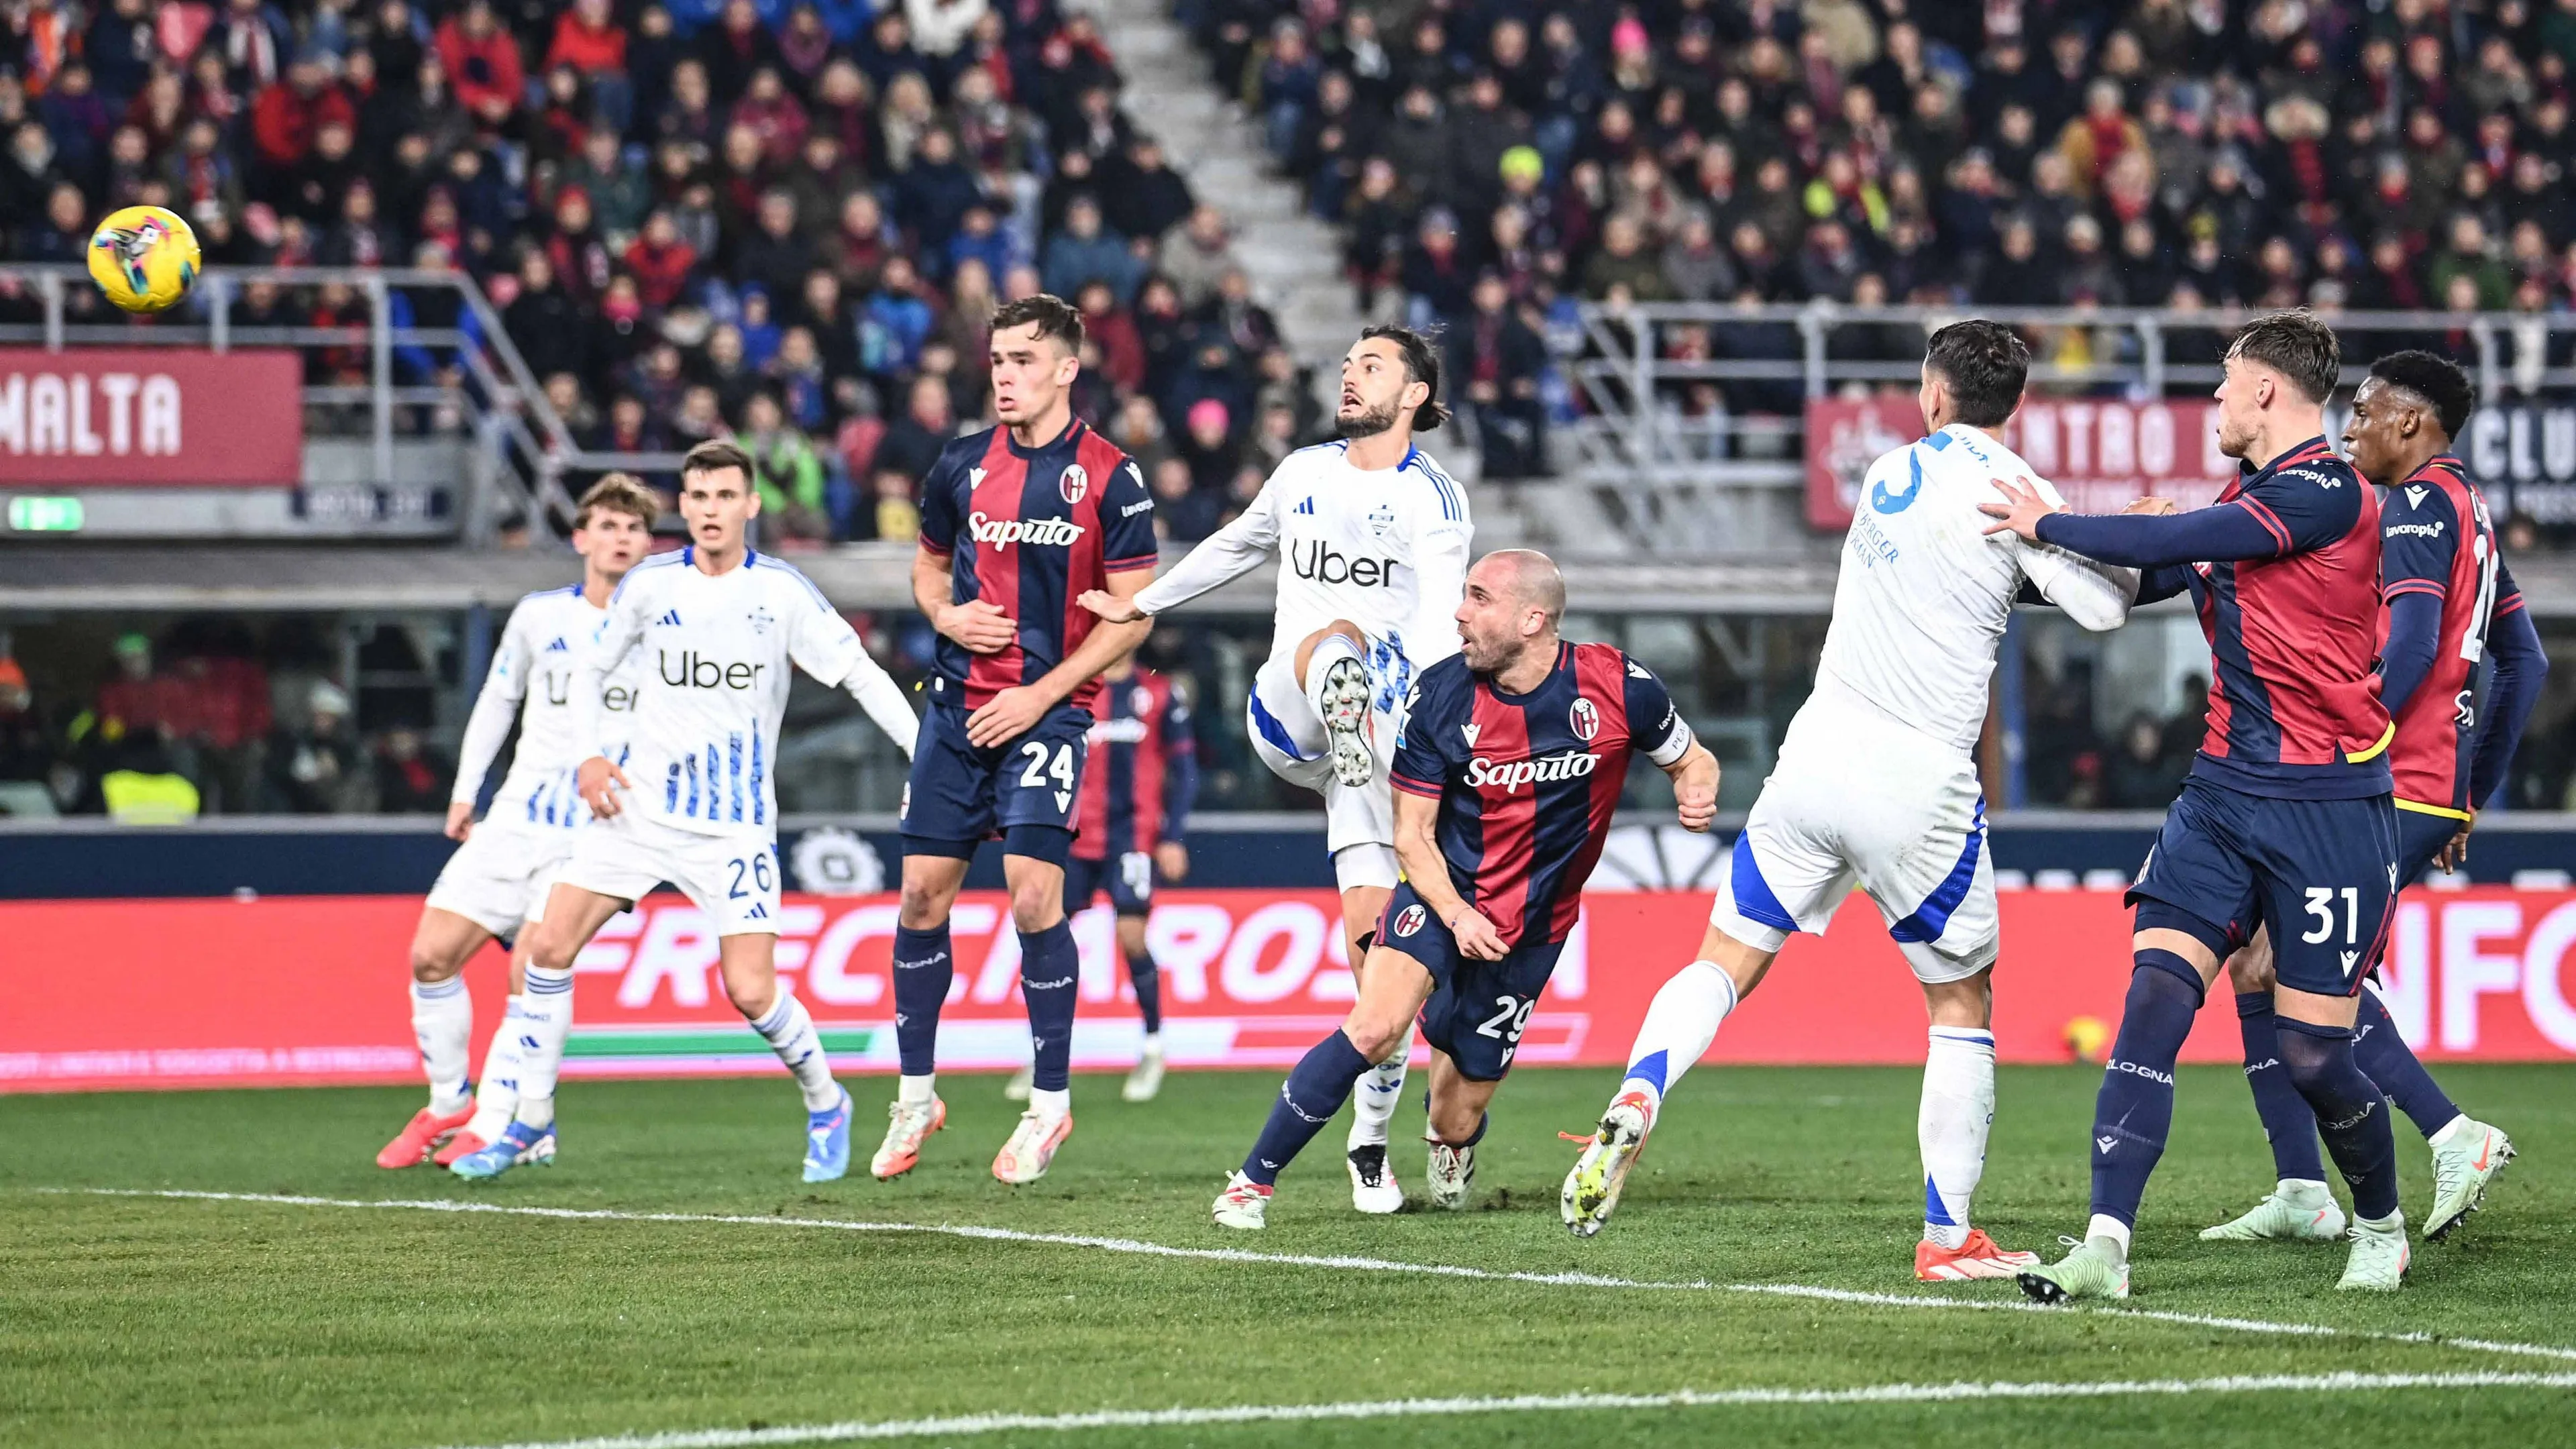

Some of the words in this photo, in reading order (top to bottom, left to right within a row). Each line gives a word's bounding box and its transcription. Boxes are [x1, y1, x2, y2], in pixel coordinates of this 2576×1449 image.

[968, 511, 1087, 553] Saputo
[1292, 537, 1399, 588] Uber
[545, 672, 639, 712] Uer
[659, 649, 765, 690] Uber
[1020, 741, 1075, 790] 24
[1463, 749, 1602, 794] Saputo
[728, 852, 773, 900] 26
[2302, 887, 2358, 945] 31
[1476, 995, 1536, 1042] 29
